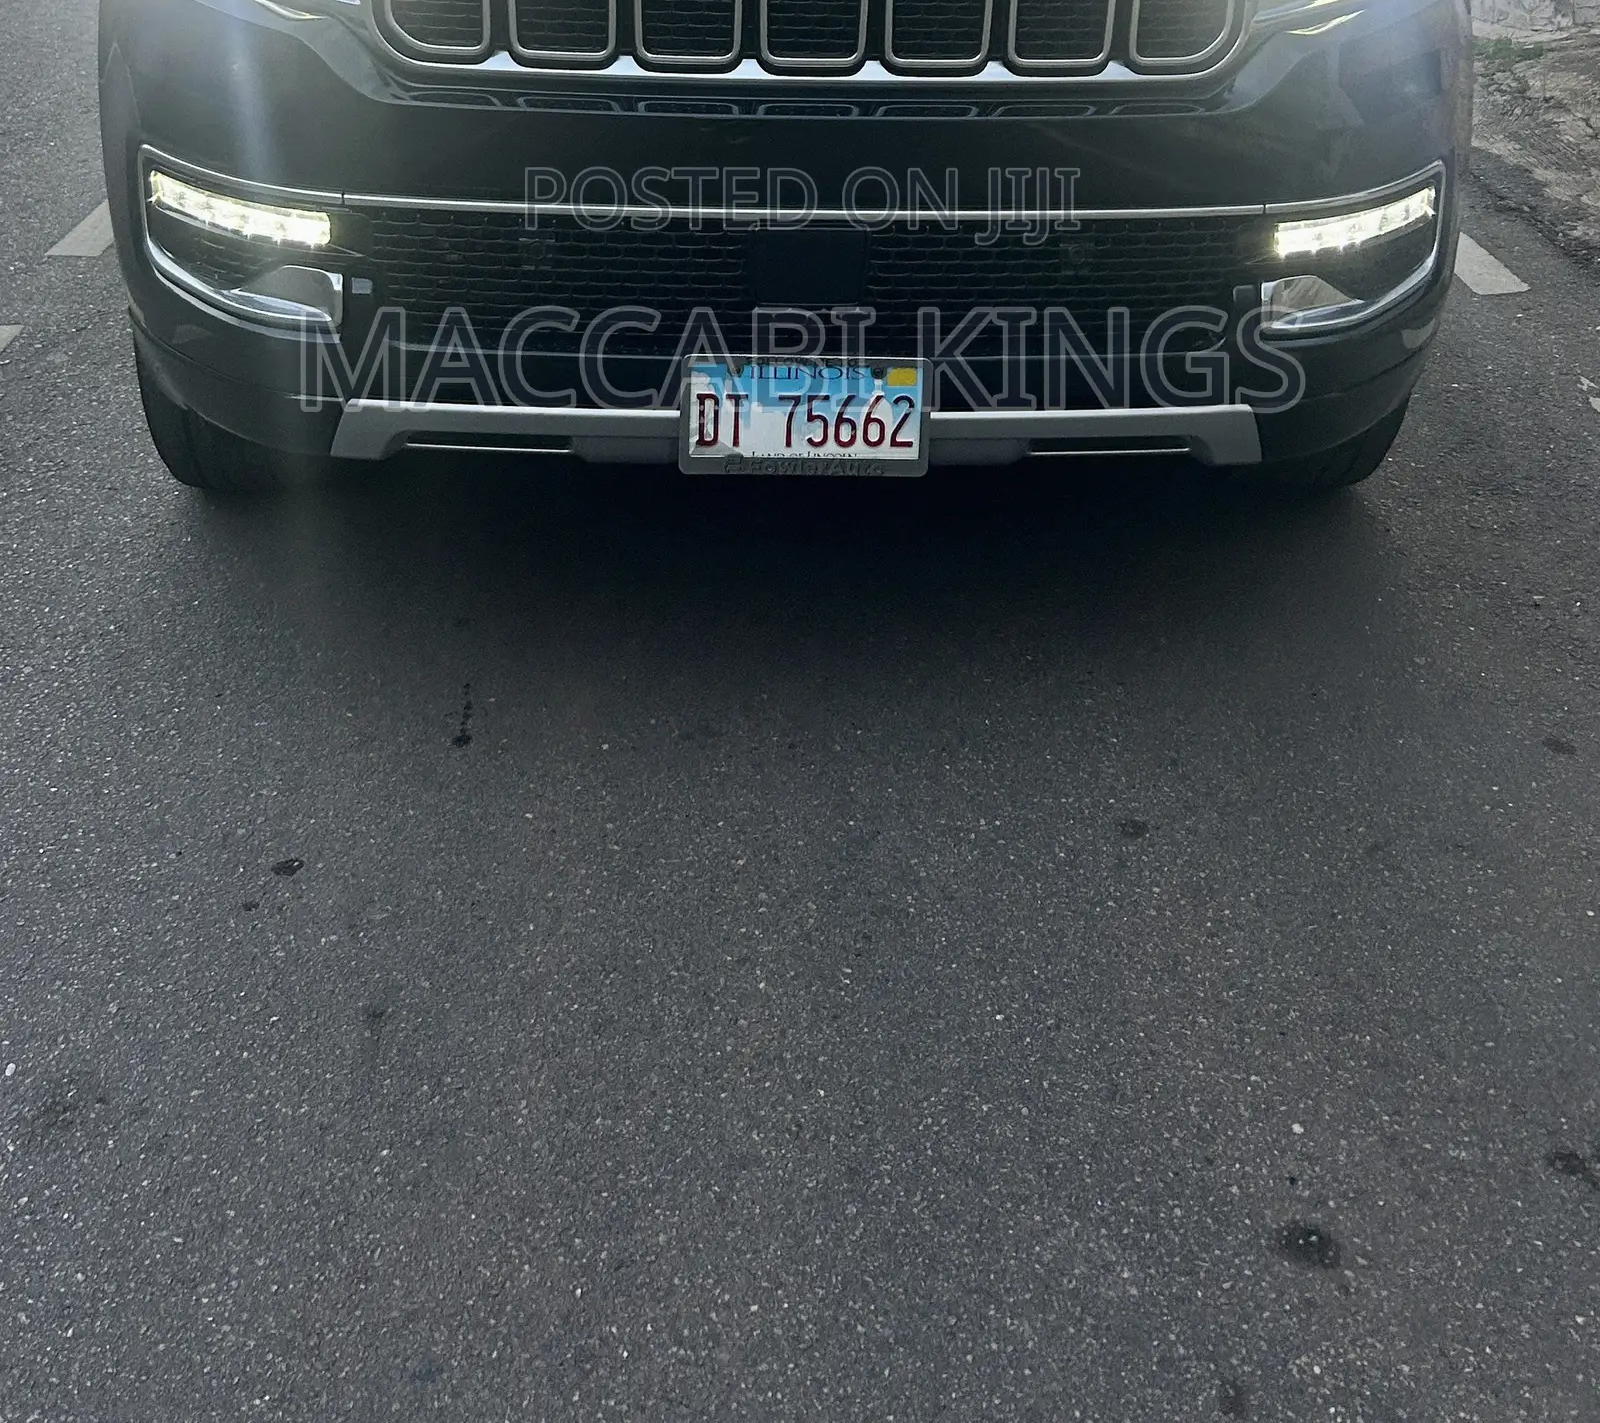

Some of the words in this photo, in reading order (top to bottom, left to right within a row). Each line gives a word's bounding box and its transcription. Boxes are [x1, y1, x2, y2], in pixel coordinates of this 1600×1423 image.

[749, 364, 867, 380] ILLINOIS
[696, 393, 749, 448] DT
[778, 393, 916, 448] 75662
